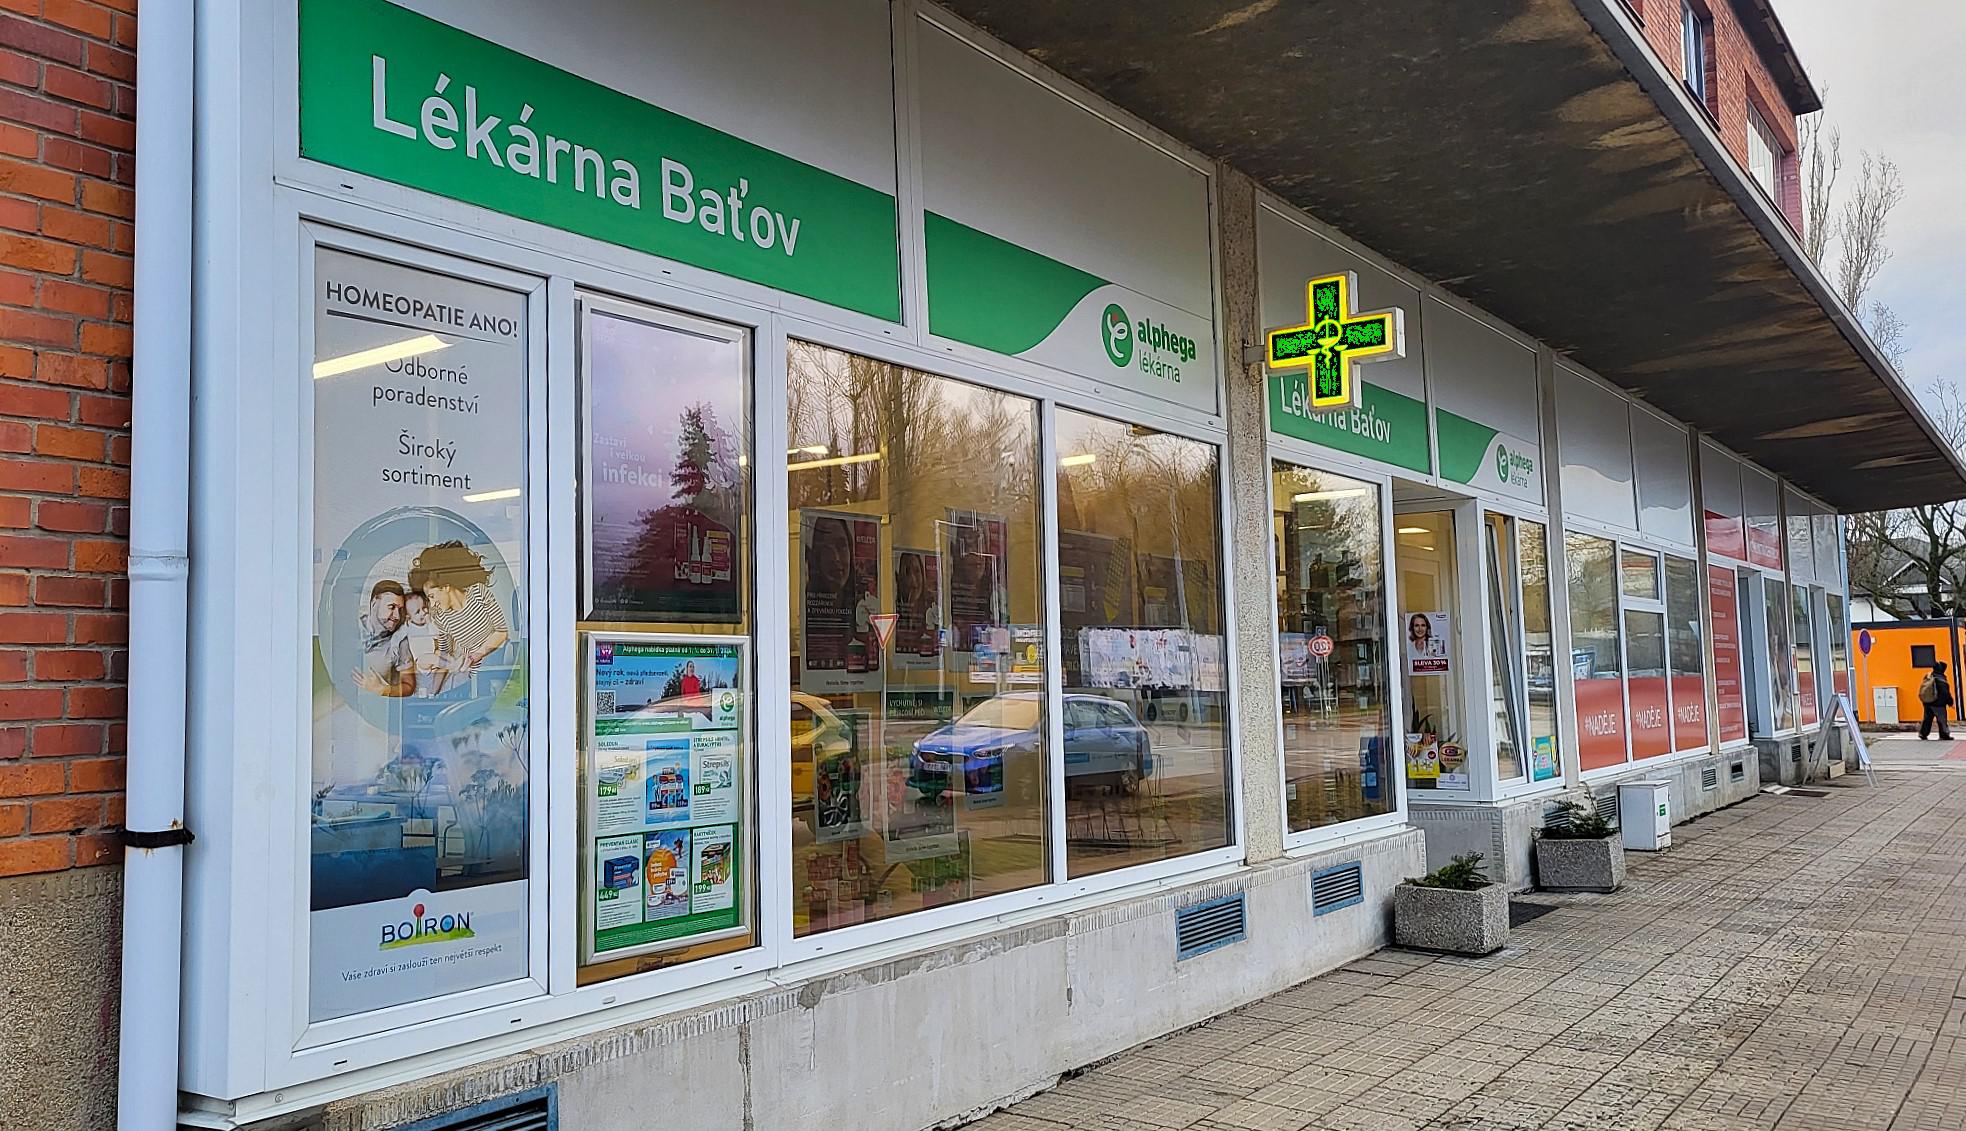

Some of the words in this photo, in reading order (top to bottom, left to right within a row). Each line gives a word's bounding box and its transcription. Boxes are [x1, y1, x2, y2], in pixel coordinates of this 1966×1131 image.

[371, 54, 641, 210] Lékárna
[661, 157, 801, 257] Baťov
[326, 280, 465, 327] HOMEOPATIE
[468, 312, 518, 338] ANO!
[1137, 317, 1196, 363] alphega
[1138, 349, 1181, 383] lékárna
[372, 385, 480, 415] poradenství
[1351, 405, 1391, 444] Baťov
[398, 429, 457, 468] Široký
[1509, 449, 1534, 476] alphega
[381, 465, 472, 490] sortiment
[602, 460, 663, 489] infekci
[342, 970, 362, 982] Vaše
[363, 966, 388, 979] zdraví
[389, 964, 397, 973] si
[397, 958, 429, 972] zaslouží
[430, 956, 443, 965] ten
[444, 950, 474, 965] největší
[474, 944, 502, 958] respekt
